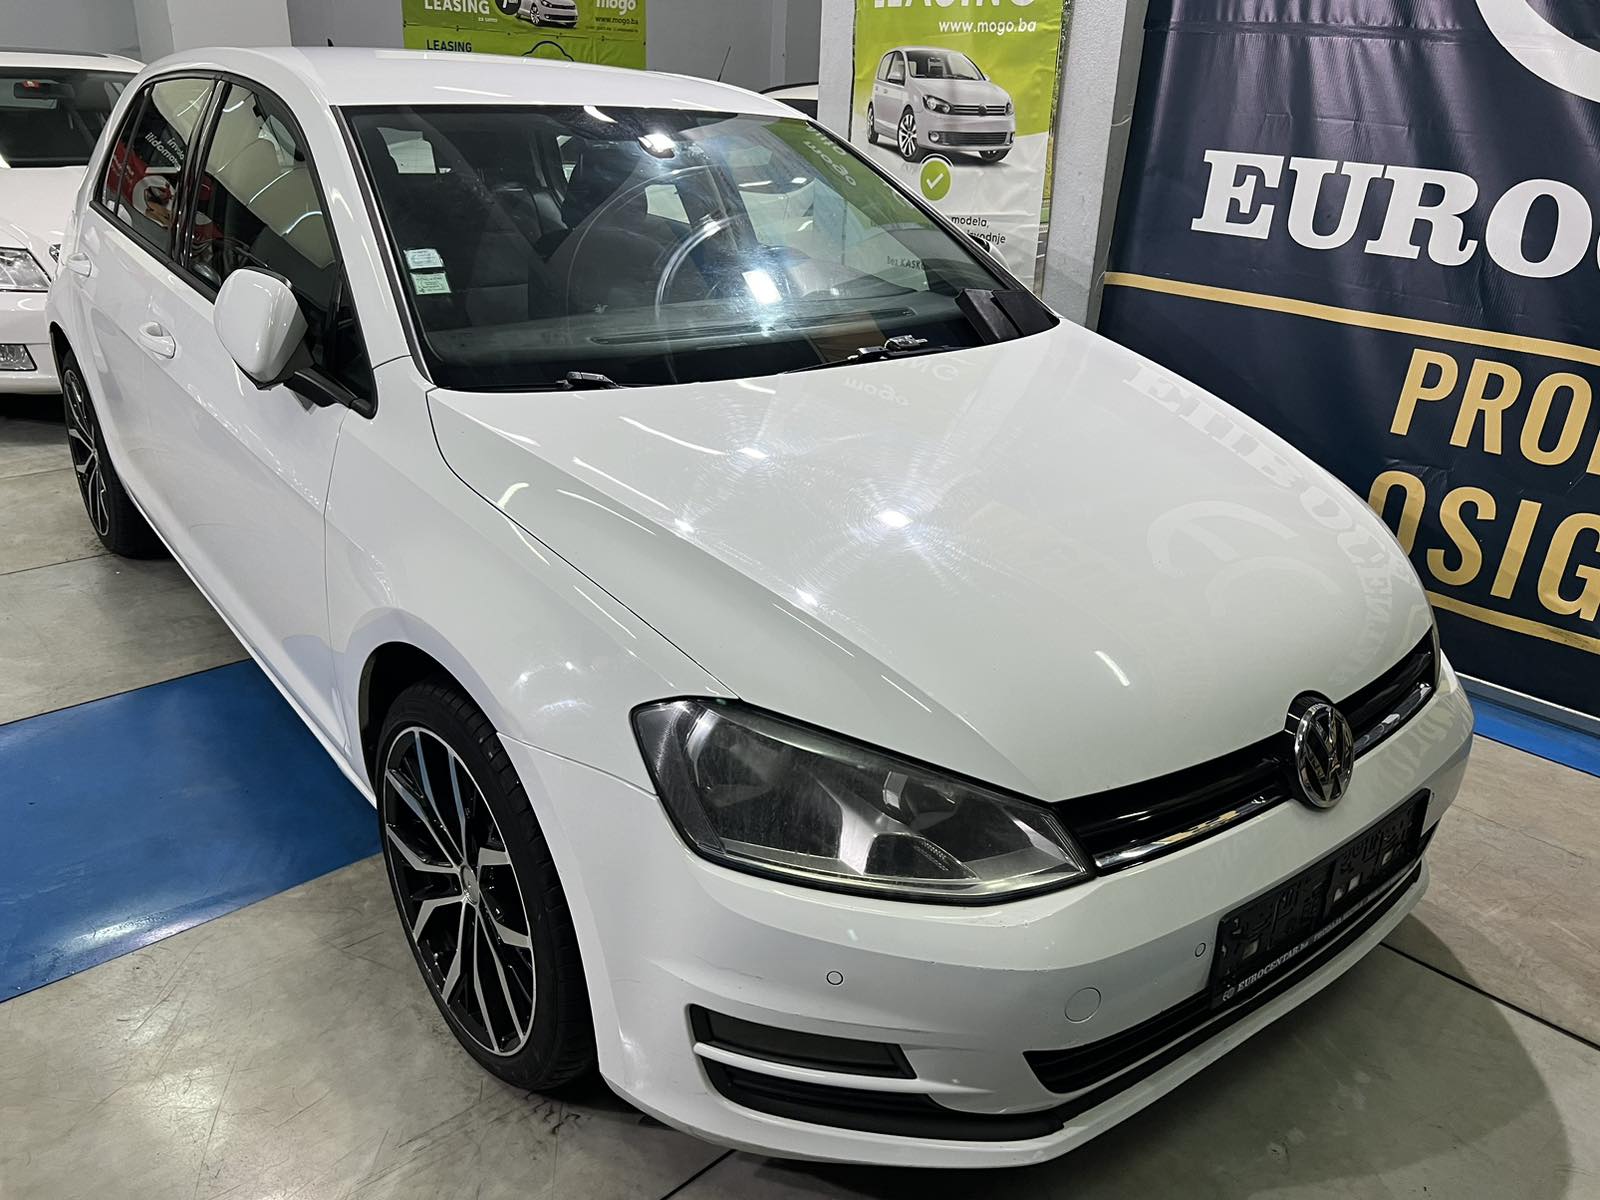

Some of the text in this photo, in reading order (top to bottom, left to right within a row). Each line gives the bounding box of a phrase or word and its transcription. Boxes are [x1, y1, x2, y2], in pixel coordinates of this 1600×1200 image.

[424, 0, 490, 15] LEASING
[938, 17, 1037, 36] www.mogo.ba
[426, 39, 472, 53] LEASING
[1190, 149, 1600, 279] EURO
[1389, 348, 1600, 476] PRO
